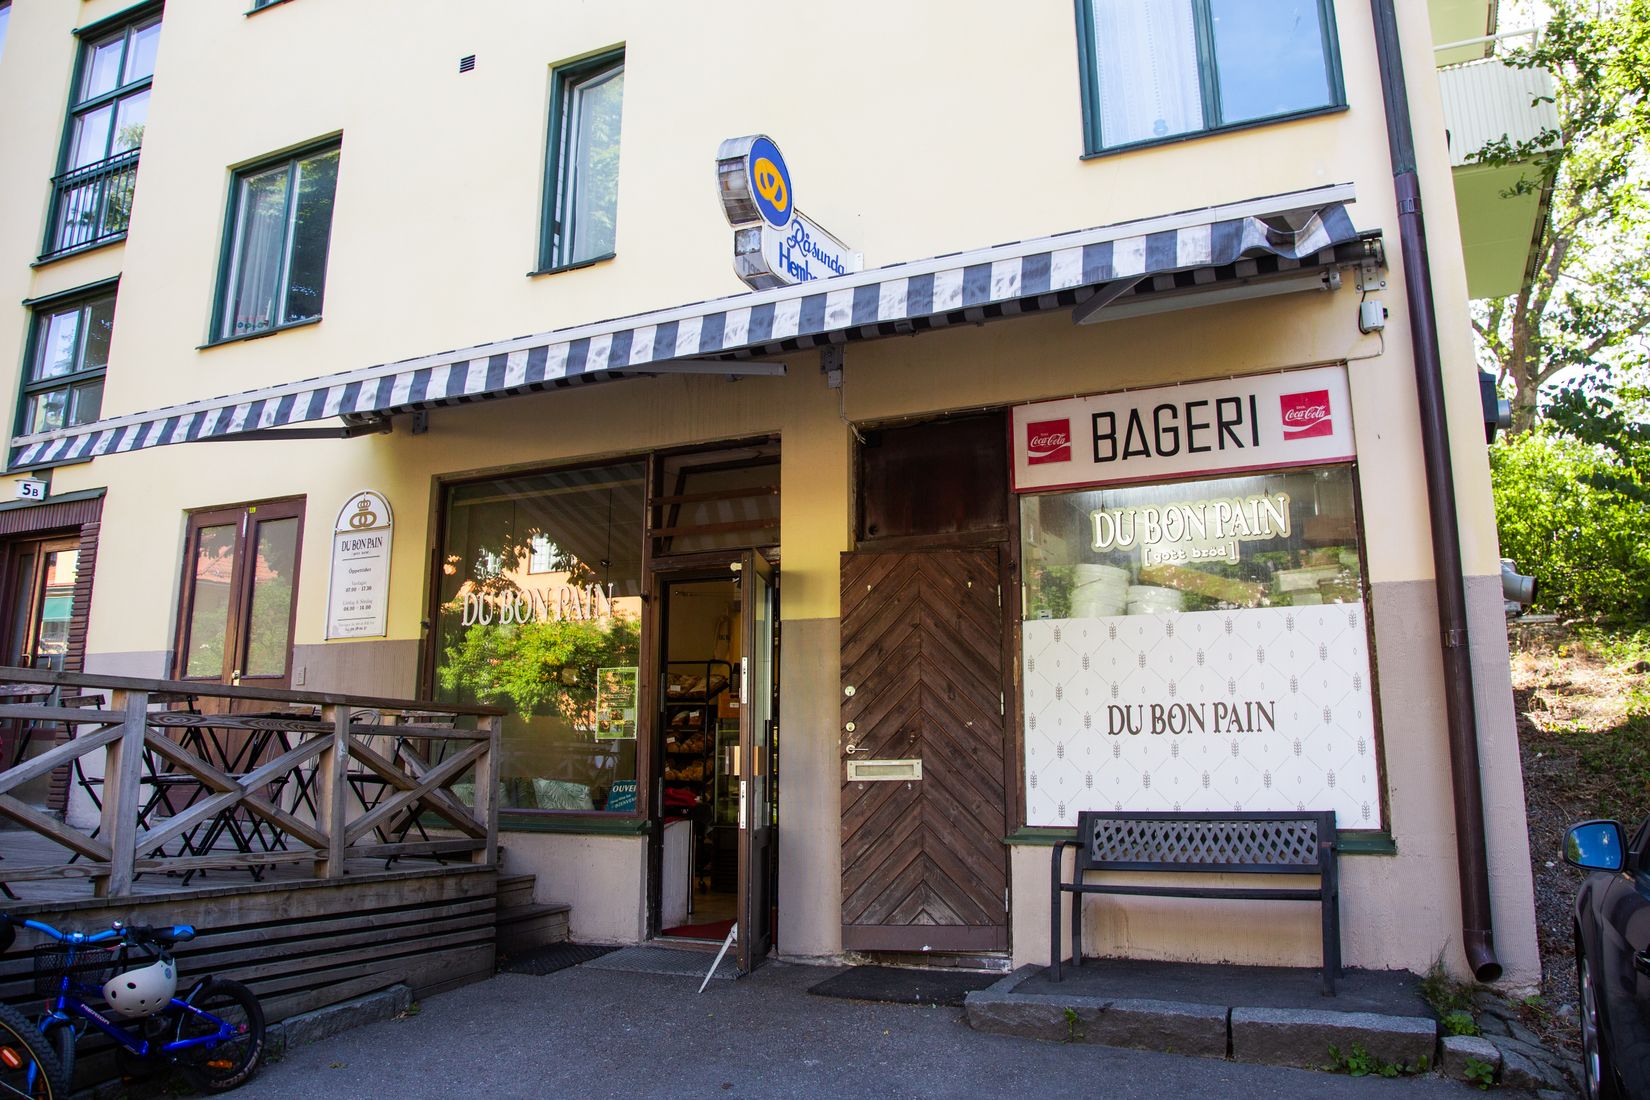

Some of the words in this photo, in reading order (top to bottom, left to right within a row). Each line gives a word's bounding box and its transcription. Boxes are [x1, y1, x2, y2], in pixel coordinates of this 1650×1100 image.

[779, 242, 818, 281] Hemb
[786, 216, 845, 275] Råsunda
[1092, 394, 1259, 463] BAGERI
[1286, 405, 1327, 421] Coca-Cola
[1030, 433, 1066, 448] Coca-Cola
[1094, 511, 1137, 548] DU
[1142, 504, 1208, 544] BON
[1212, 496, 1287, 539] PAIN
[341, 540, 352, 552] DU
[352, 538, 367, 550] BON
[367, 536, 383, 549] PAIN
[461, 591, 495, 626] DU
[499, 587, 551, 624] BON
[555, 582, 614, 621] PAIN
[1107, 704, 1143, 735] DU
[1150, 703, 1206, 735] BON
[1212, 700, 1276, 734] PAIN
